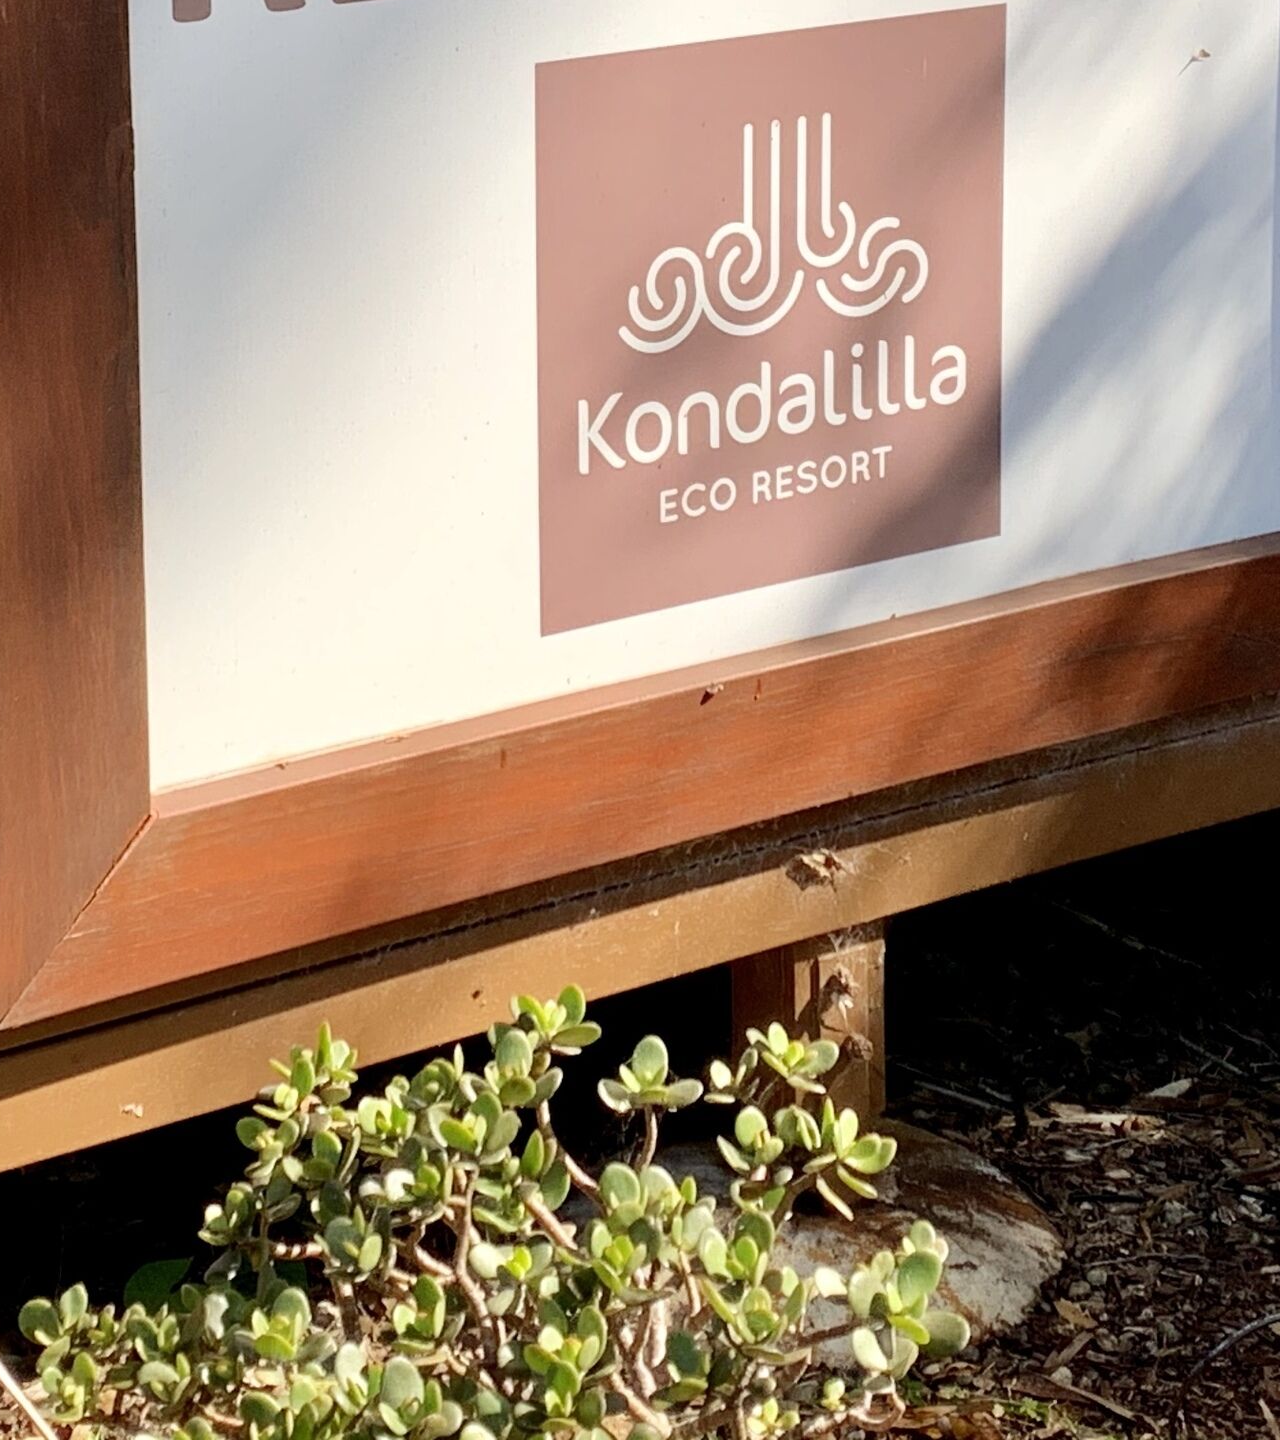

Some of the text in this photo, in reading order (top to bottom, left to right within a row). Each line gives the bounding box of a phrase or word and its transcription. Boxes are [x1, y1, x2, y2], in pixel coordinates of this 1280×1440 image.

[578, 335, 967, 475] Kondalilla
[659, 445, 893, 523] ECO RESORT
